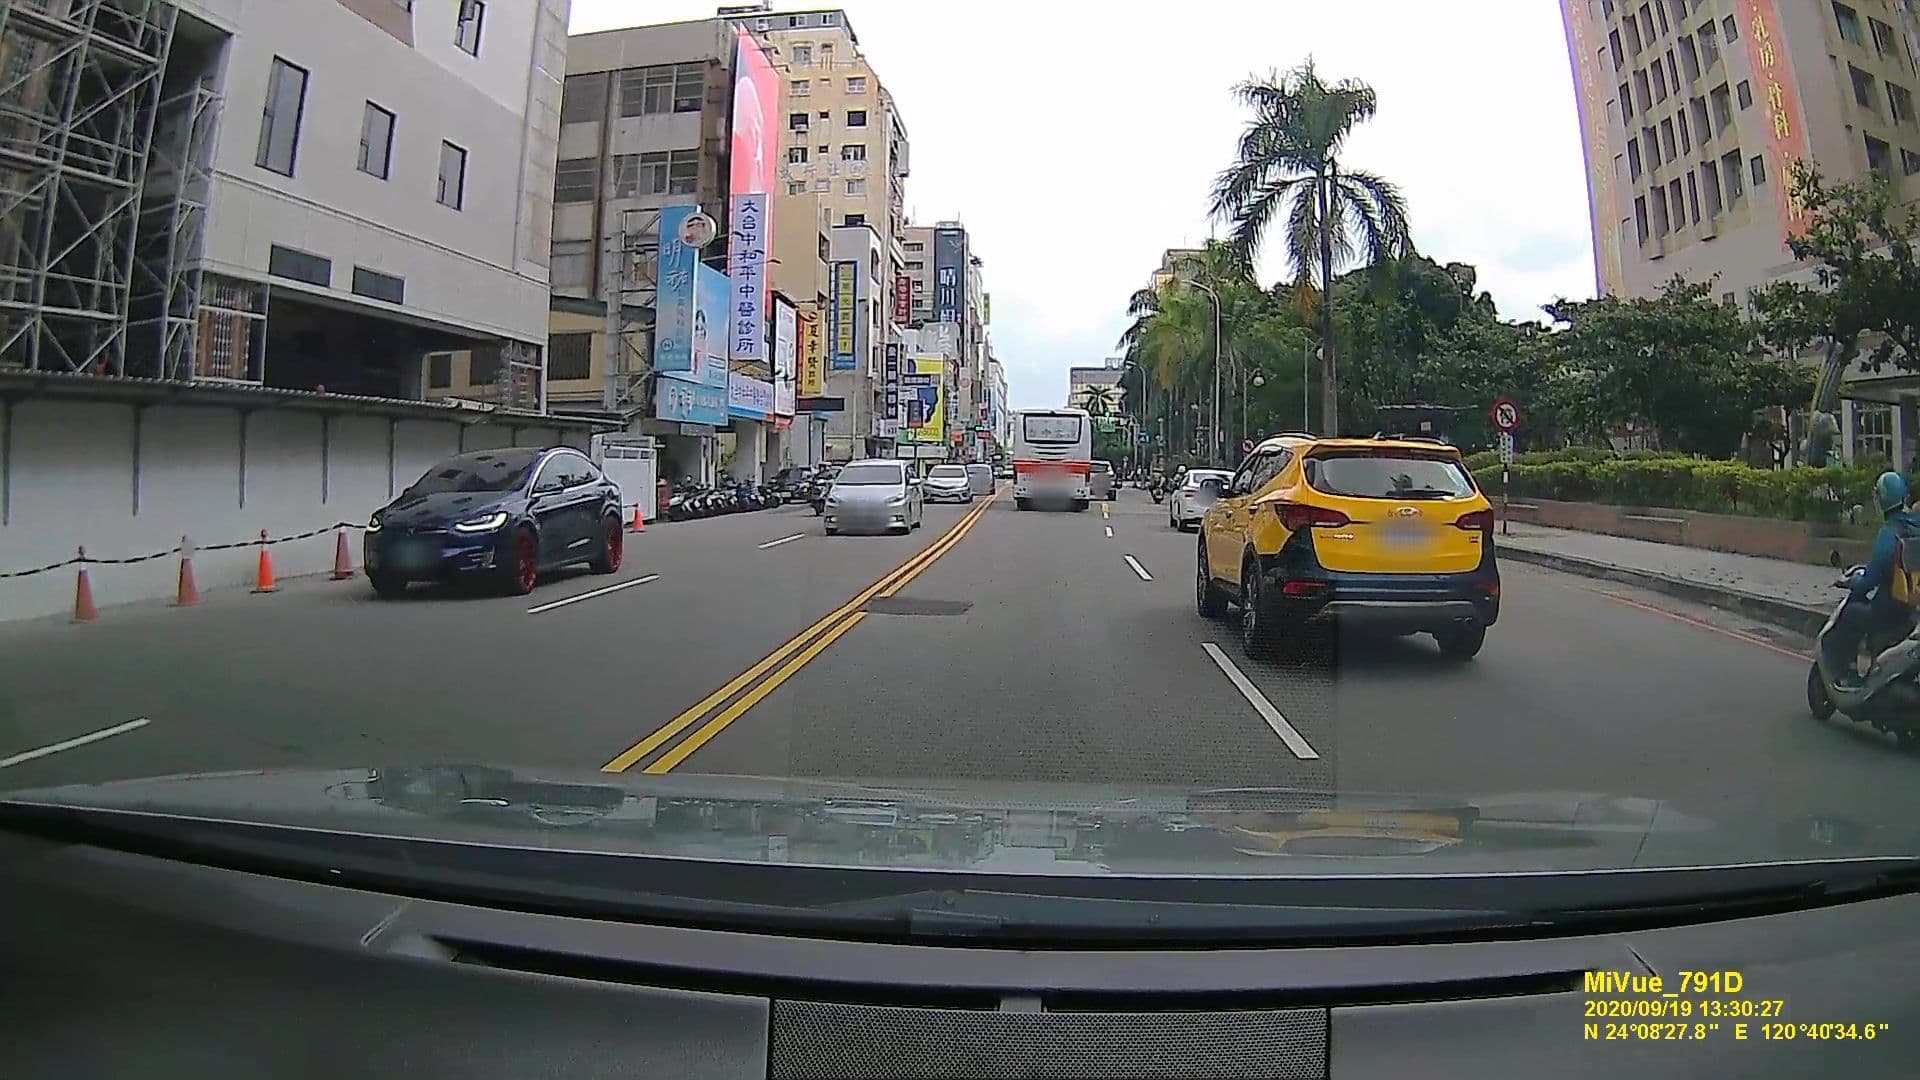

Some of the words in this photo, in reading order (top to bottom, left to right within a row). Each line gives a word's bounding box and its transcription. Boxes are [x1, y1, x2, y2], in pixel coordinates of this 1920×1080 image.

[736, 200, 759, 353] 大台中和平中醫診所
